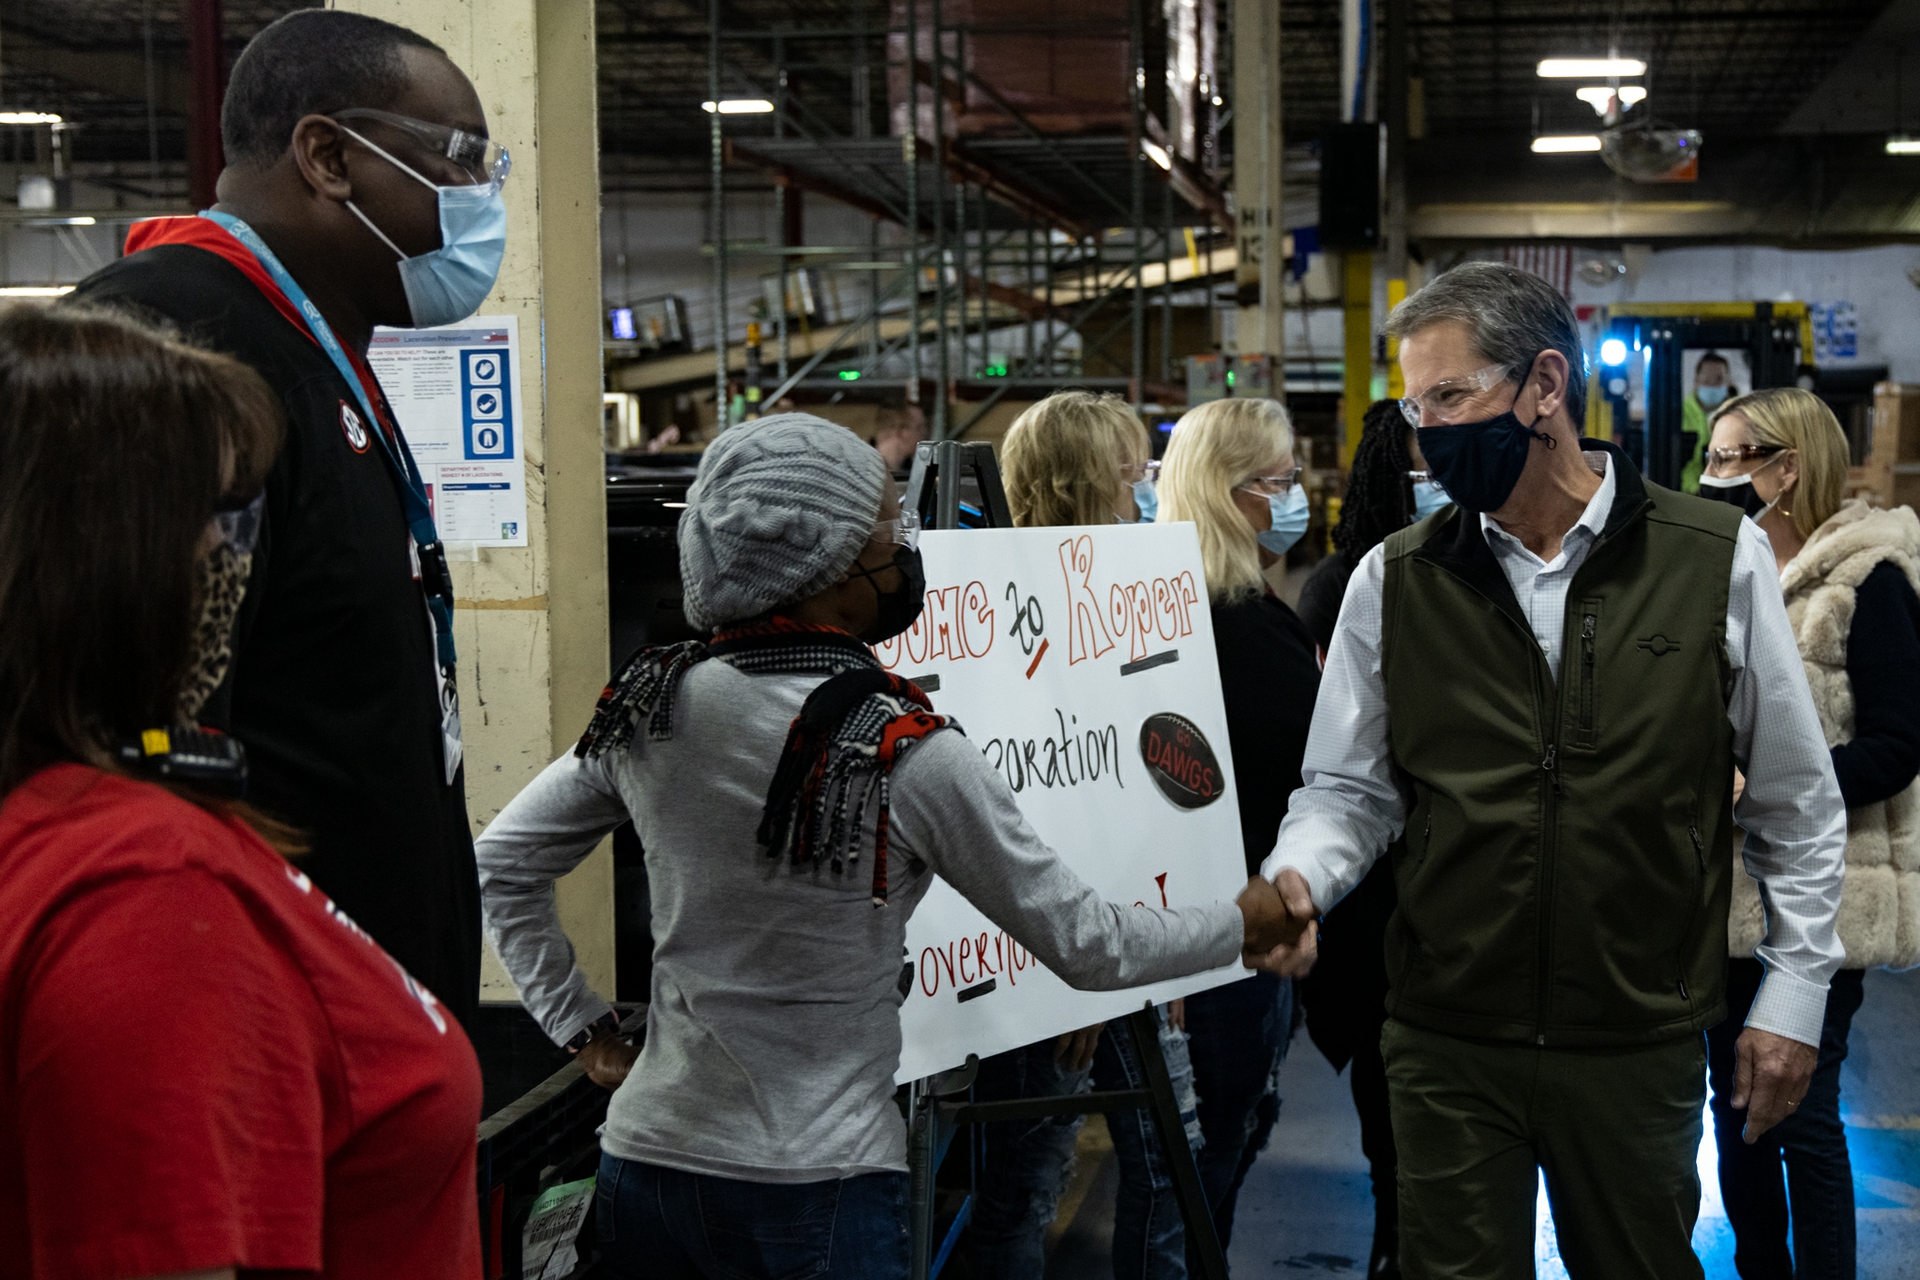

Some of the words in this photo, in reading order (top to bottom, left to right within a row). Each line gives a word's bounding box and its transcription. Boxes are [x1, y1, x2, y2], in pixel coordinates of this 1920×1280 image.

[403, 335, 438, 343] Laceration
[438, 334, 472, 342] Prevention
[1005, 580, 1044, 656] to
[1058, 533, 1199, 667] Roper
[1176, 727, 1191, 748] GO
[1146, 731, 1214, 798] DAWGS
